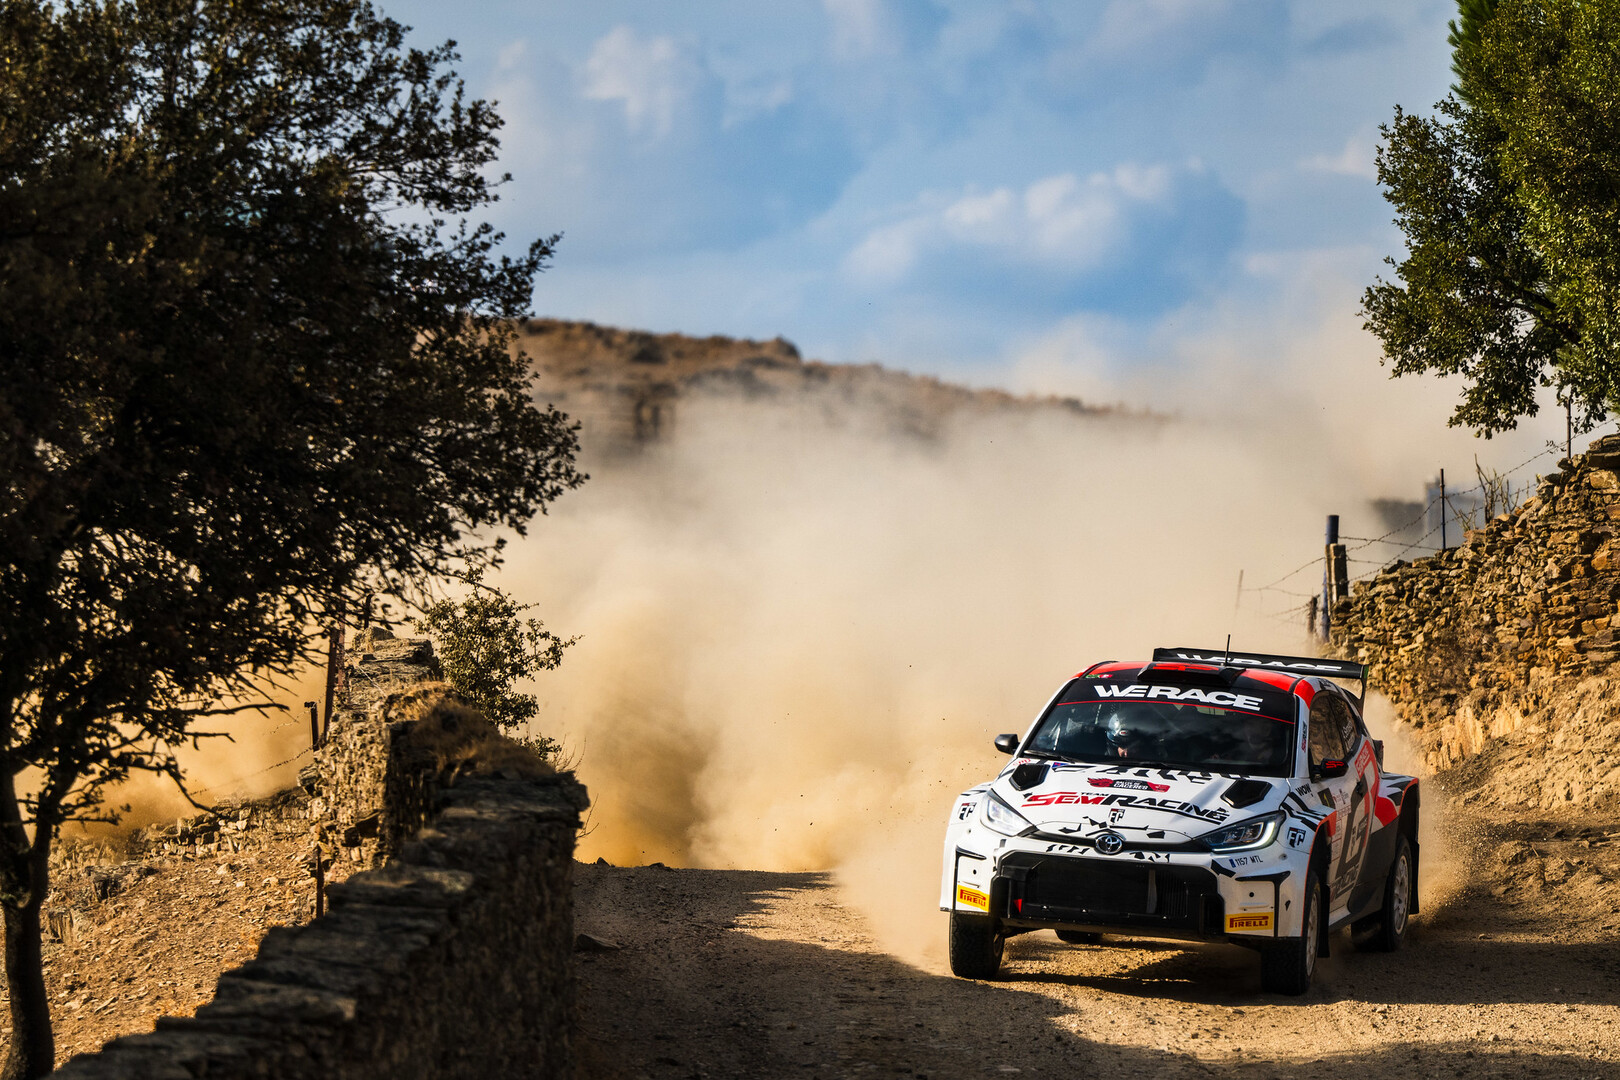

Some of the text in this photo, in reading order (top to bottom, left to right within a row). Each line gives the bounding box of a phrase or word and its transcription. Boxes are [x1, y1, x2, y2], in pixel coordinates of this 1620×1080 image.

[1093, 684, 1264, 712] WERACE
[960, 888, 987, 907] PIRELLI
[1229, 915, 1269, 929] PIRELLI
